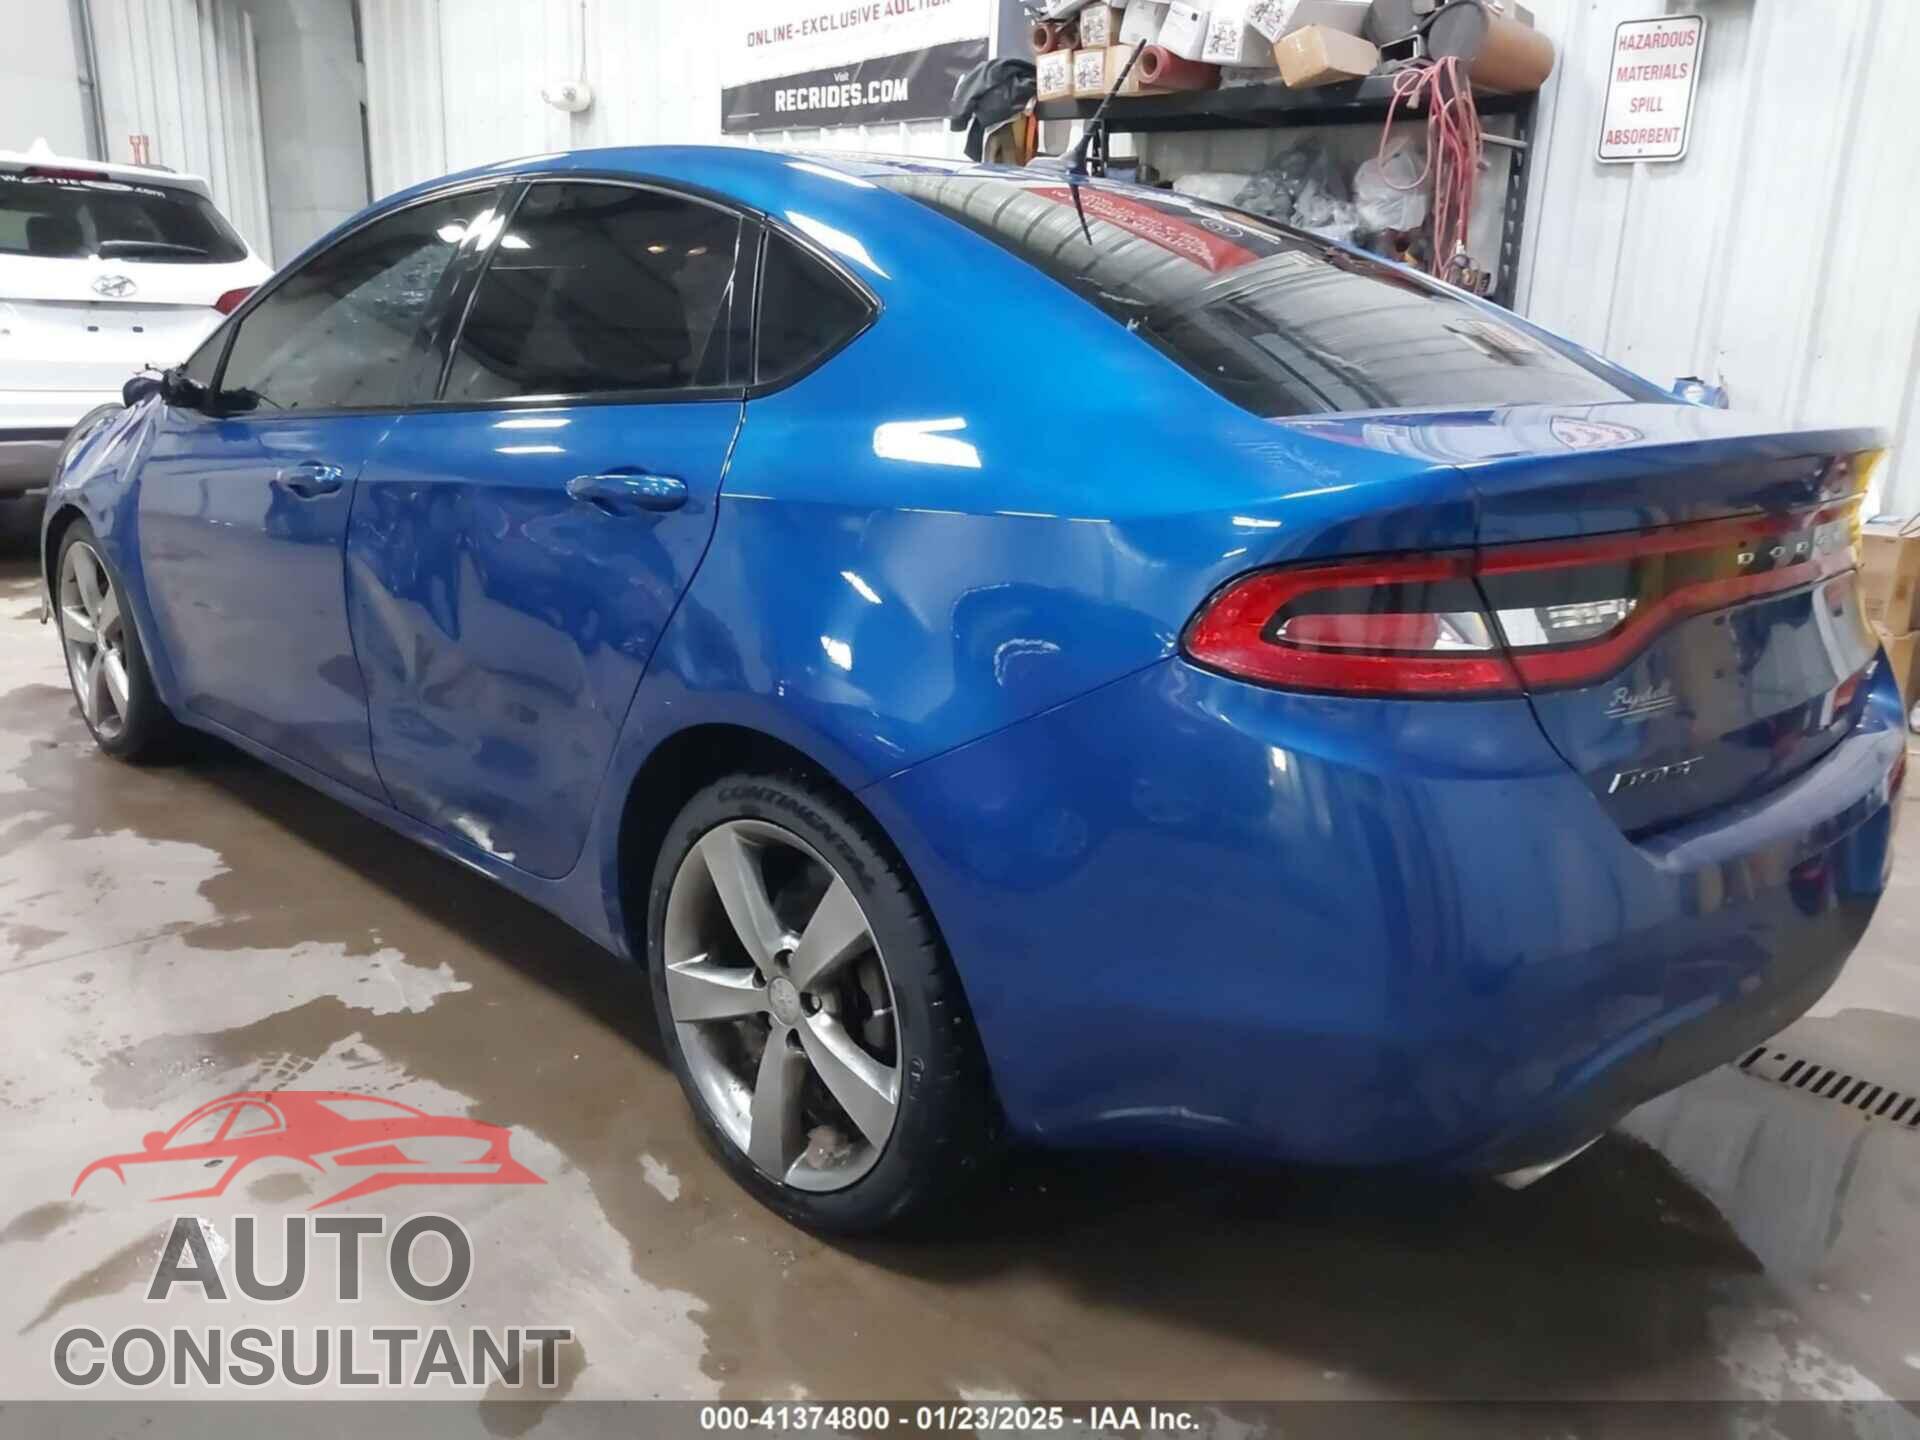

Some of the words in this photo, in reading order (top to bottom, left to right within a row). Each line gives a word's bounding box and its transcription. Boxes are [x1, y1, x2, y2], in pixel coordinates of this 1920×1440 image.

[746, 3, 881, 48] ONLINE-EXCLUSIVE
[884, 0, 951, 16] AUCTI
[1618, 29, 1696, 51] HAZARDOUS
[1616, 62, 1688, 82] MATERIALS
[775, 78, 908, 112] RECRIDES.COM
[1630, 96, 1664, 113] SPILL
[1605, 127, 1681, 145] ABSORBENT
